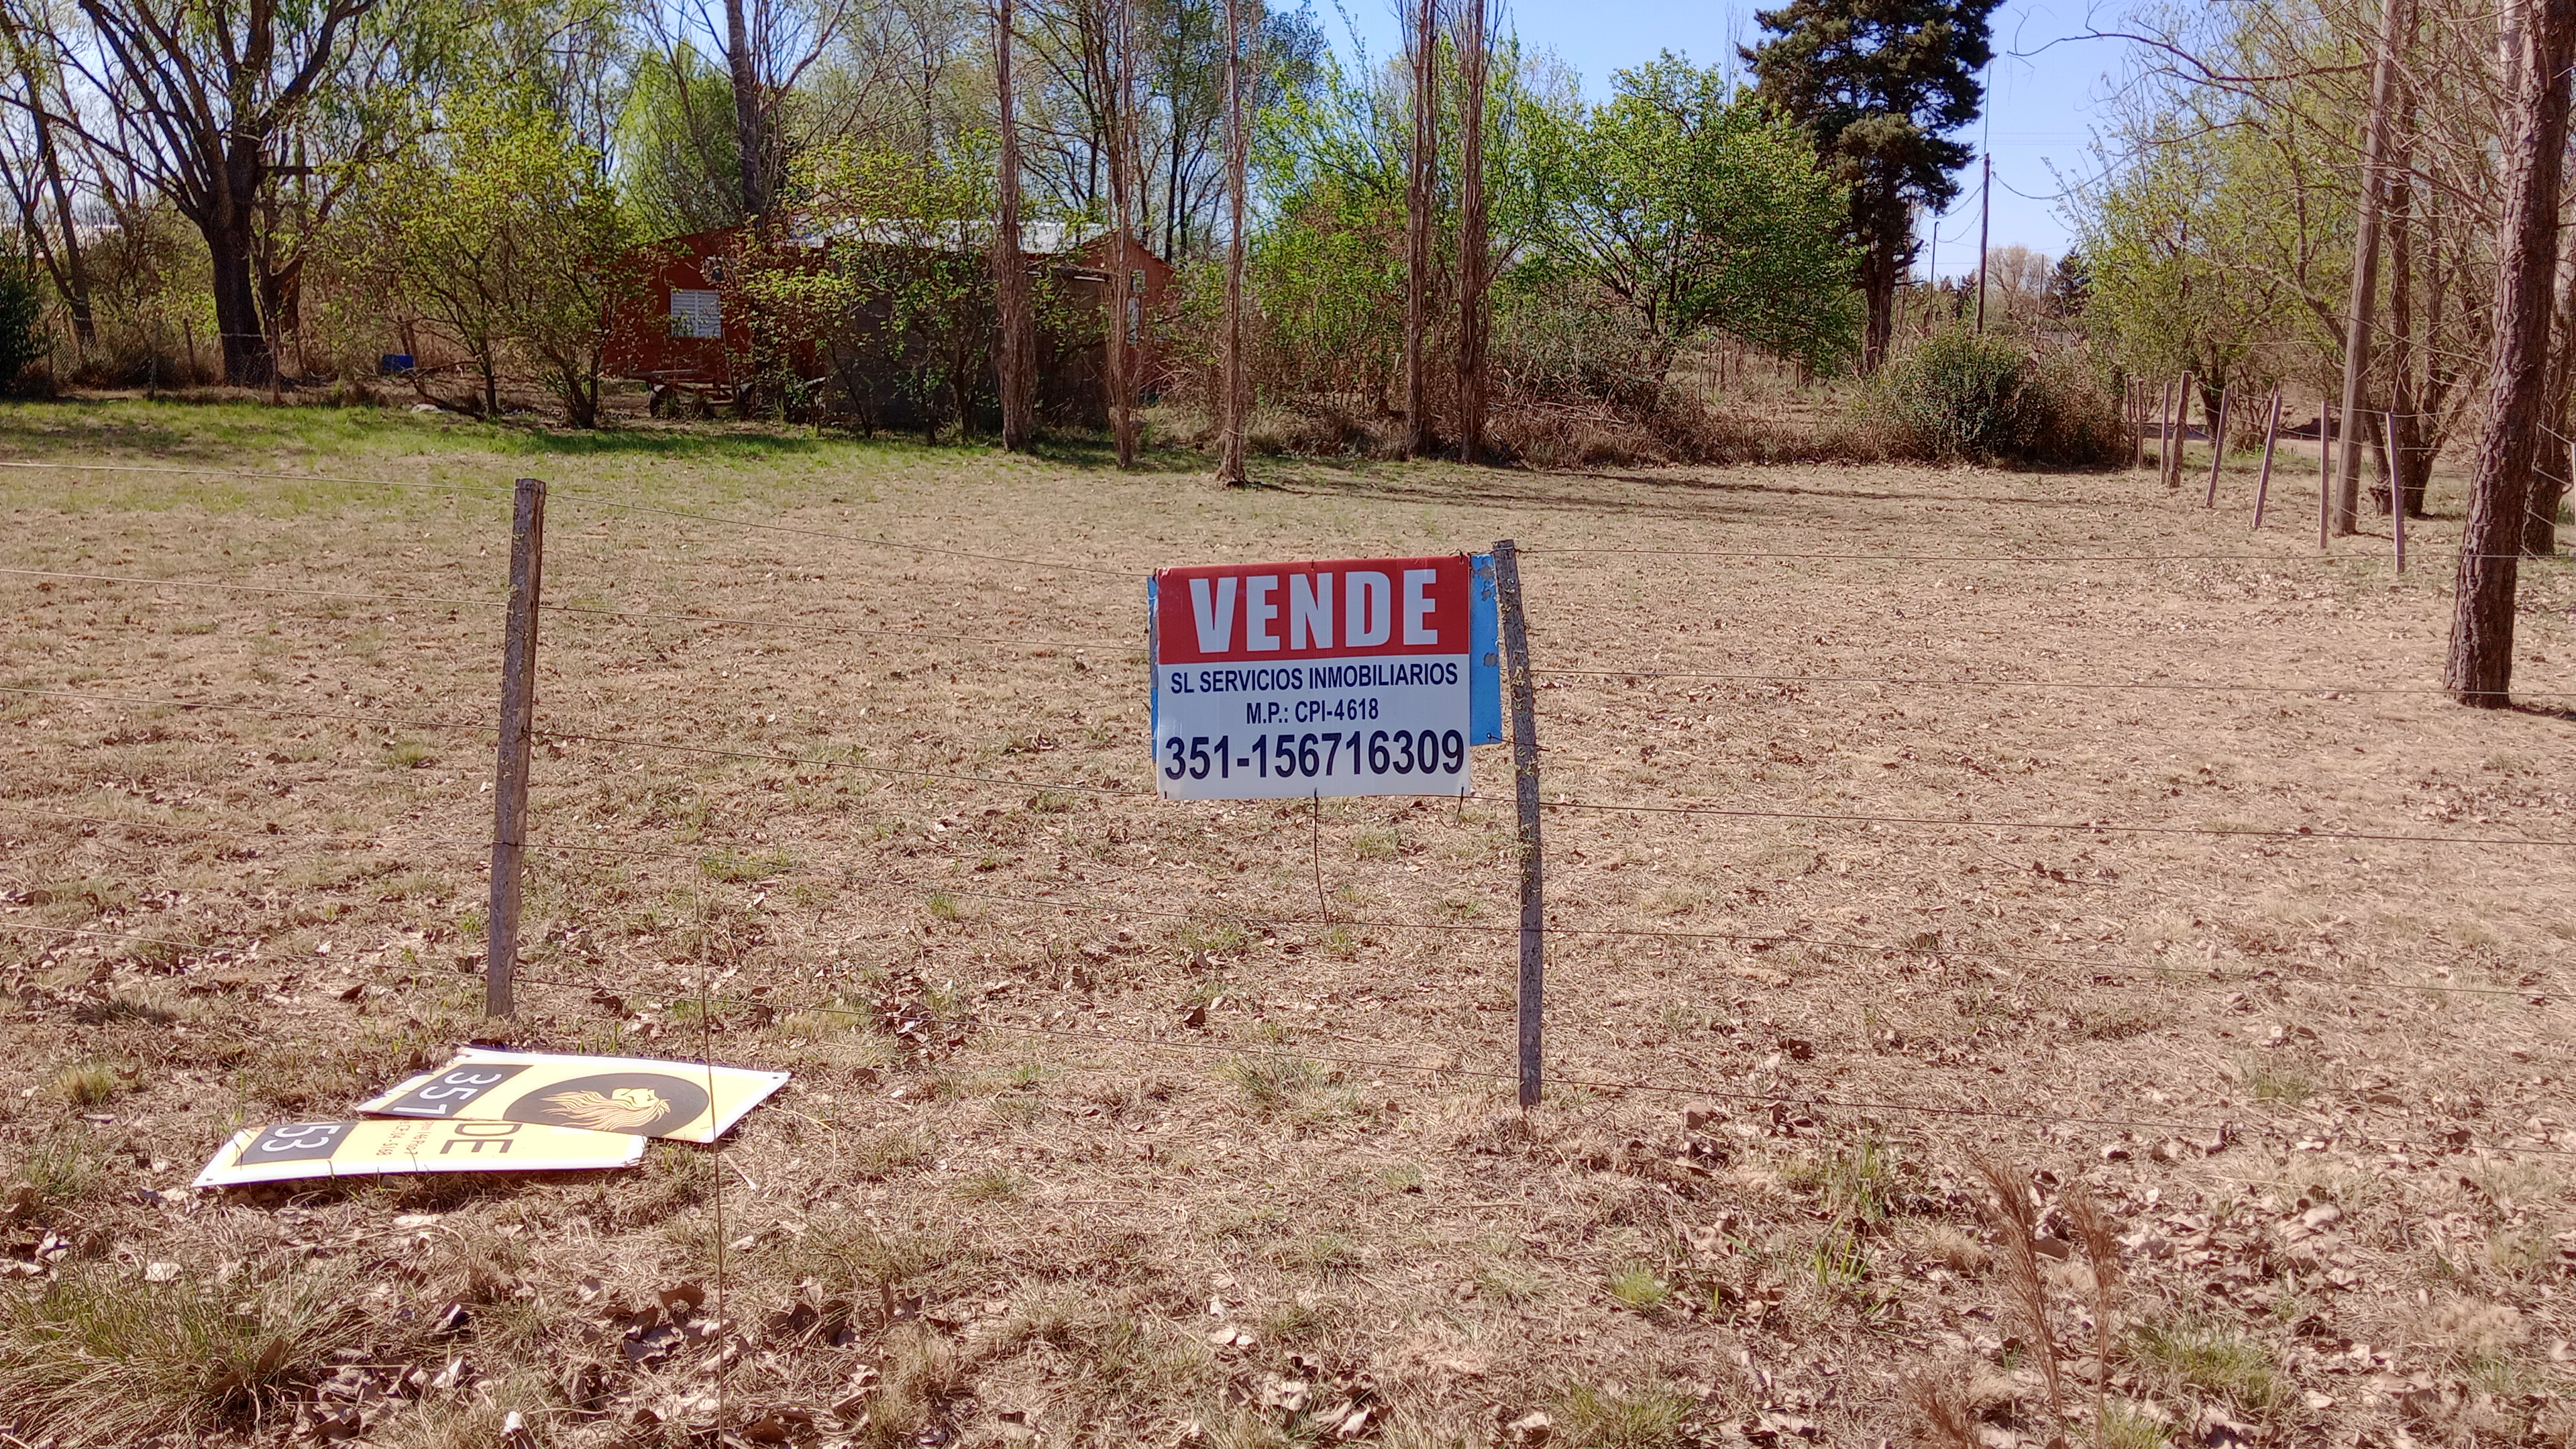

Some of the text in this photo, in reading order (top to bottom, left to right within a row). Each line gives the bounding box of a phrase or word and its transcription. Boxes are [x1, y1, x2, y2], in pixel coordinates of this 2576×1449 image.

[1188, 568, 1438, 654] VENDE
[1170, 662, 1458, 694] SL SERVICIOS INMOBILIARIOS
[1246, 698, 1379, 724] M.P.: CPI-4618
[1165, 729, 1464, 780] 351-156716309
[392, 1071, 502, 1116] 351
[261, 1124, 341, 1152] 53
[439, 1123, 523, 1155] DE
